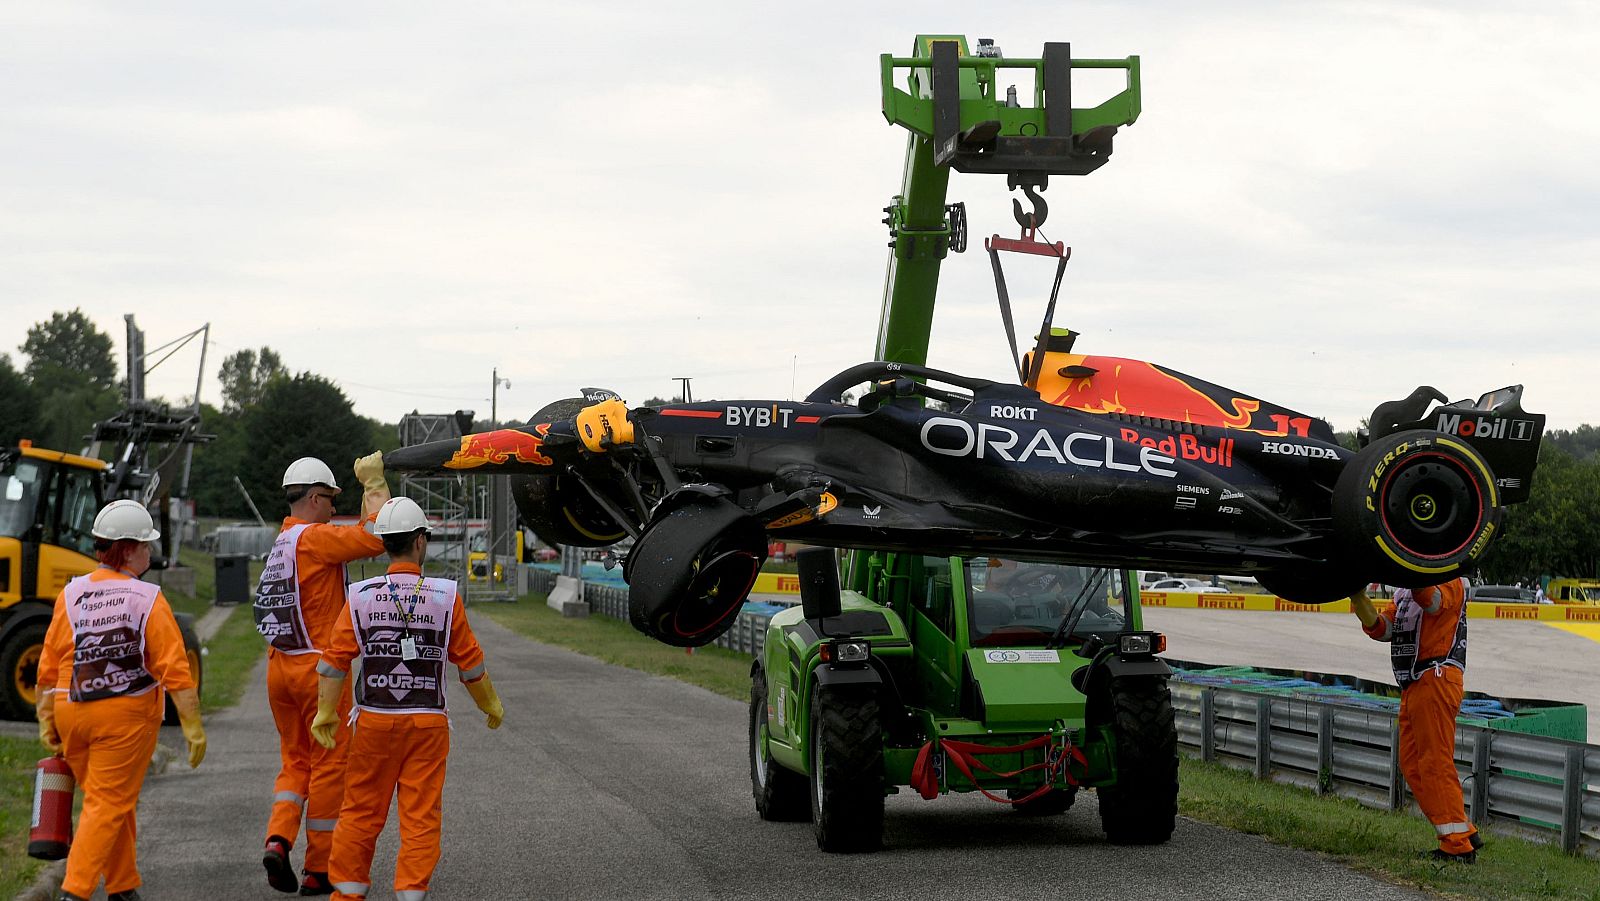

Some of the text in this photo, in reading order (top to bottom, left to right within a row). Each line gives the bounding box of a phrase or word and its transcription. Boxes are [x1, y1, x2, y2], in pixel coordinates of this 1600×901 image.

[726, 404, 794, 429] BYBIT
[990, 405, 1038, 420] ROKT
[1269, 414, 1312, 437] 11
[1436, 413, 1508, 439] Mobil
[920, 416, 1179, 478] ORACLE
[1120, 428, 1235, 468] Red Bull
[1261, 441, 1342, 461] HONDA
[1366, 442, 1408, 511] P ZERO
[1176, 484, 1210, 495] SIEMENS
[81, 597, 125, 612] 0350-HUN
[375, 594, 426, 604] 037-HN
[1198, 594, 1245, 609] PIRELLI
[92, 613, 133, 627] MARSHAL
[1495, 605, 1539, 619] PIRELLI
[367, 674, 436, 690] COURSE
